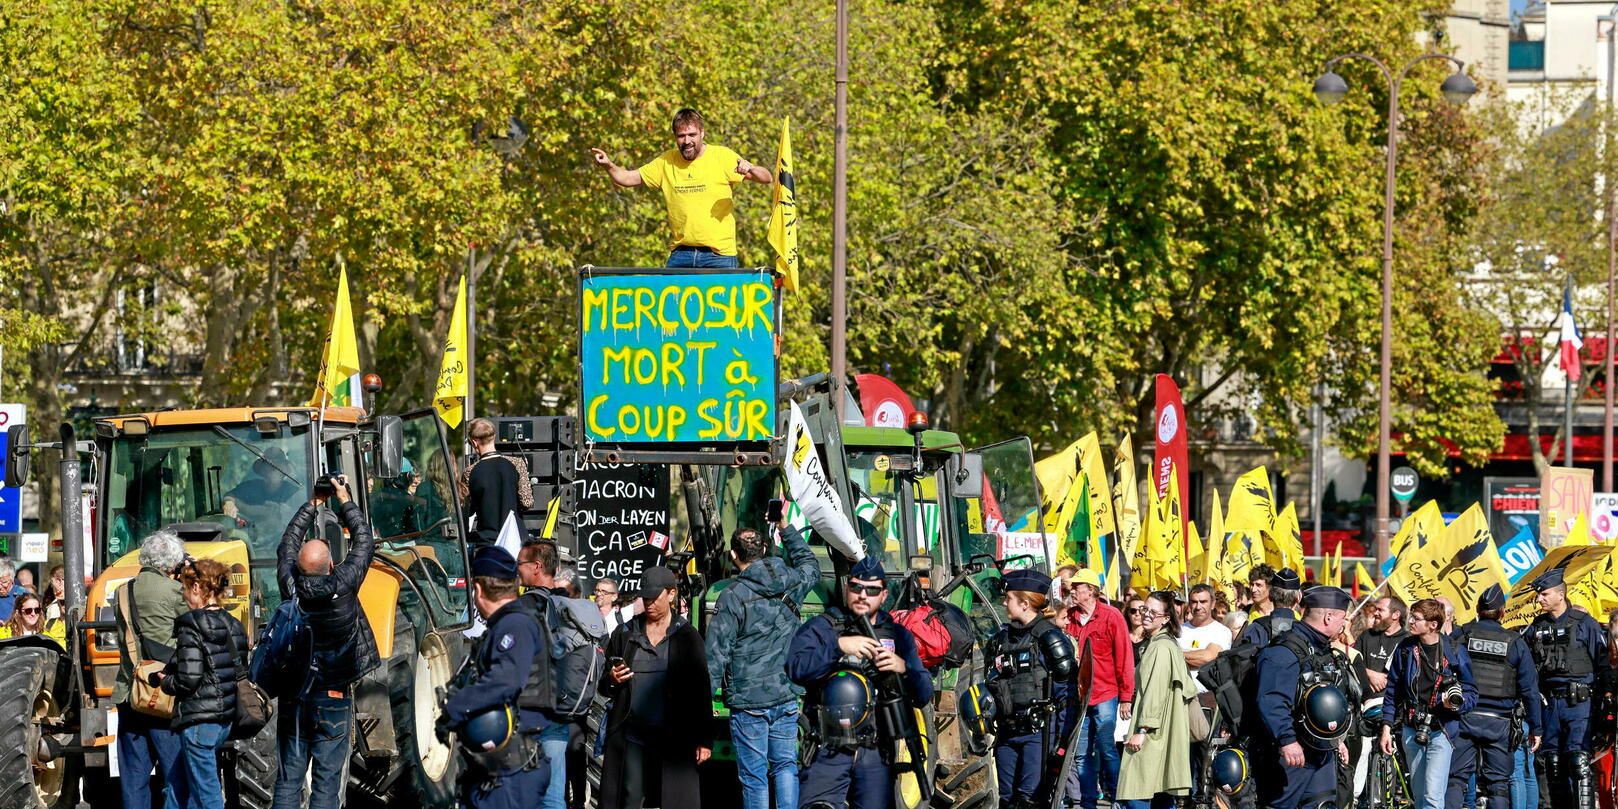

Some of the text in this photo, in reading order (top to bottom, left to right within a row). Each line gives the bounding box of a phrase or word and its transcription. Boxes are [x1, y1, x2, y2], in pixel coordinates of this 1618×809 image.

[583, 283, 773, 332] MERCOSUR
[602, 341, 717, 385] MORT
[588, 389, 771, 441] COUP SÛR
[1393, 475, 1414, 486] BUS
[575, 509, 597, 527] ON
[588, 530, 623, 555] ÇA
[578, 555, 644, 579] ÉGAGE
[1472, 640, 1505, 654] CRS
